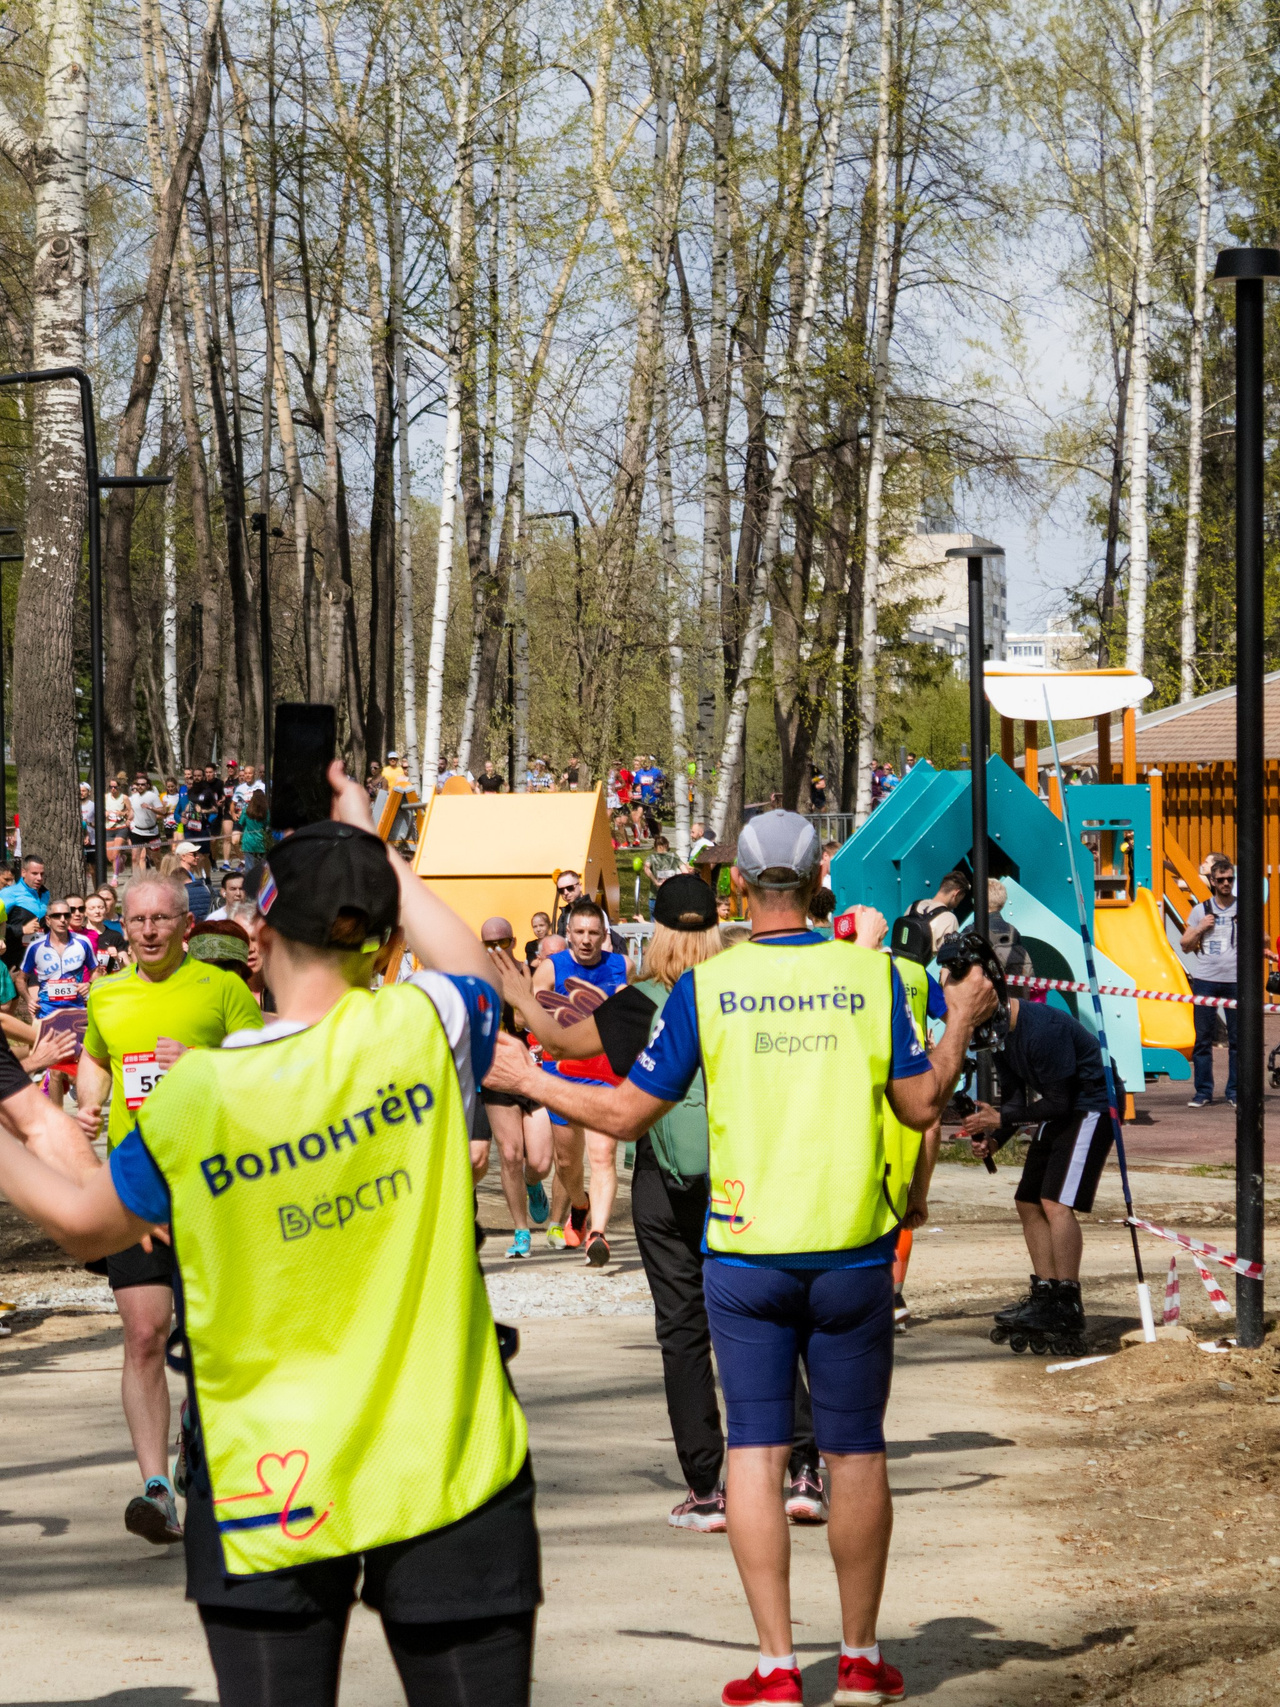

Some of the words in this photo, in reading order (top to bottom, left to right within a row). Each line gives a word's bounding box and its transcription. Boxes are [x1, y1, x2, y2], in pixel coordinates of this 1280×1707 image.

[54, 987, 72, 995] 863
[720, 986, 865, 1015] Волонтёр
[200, 1082, 435, 1198] Волонтёр
